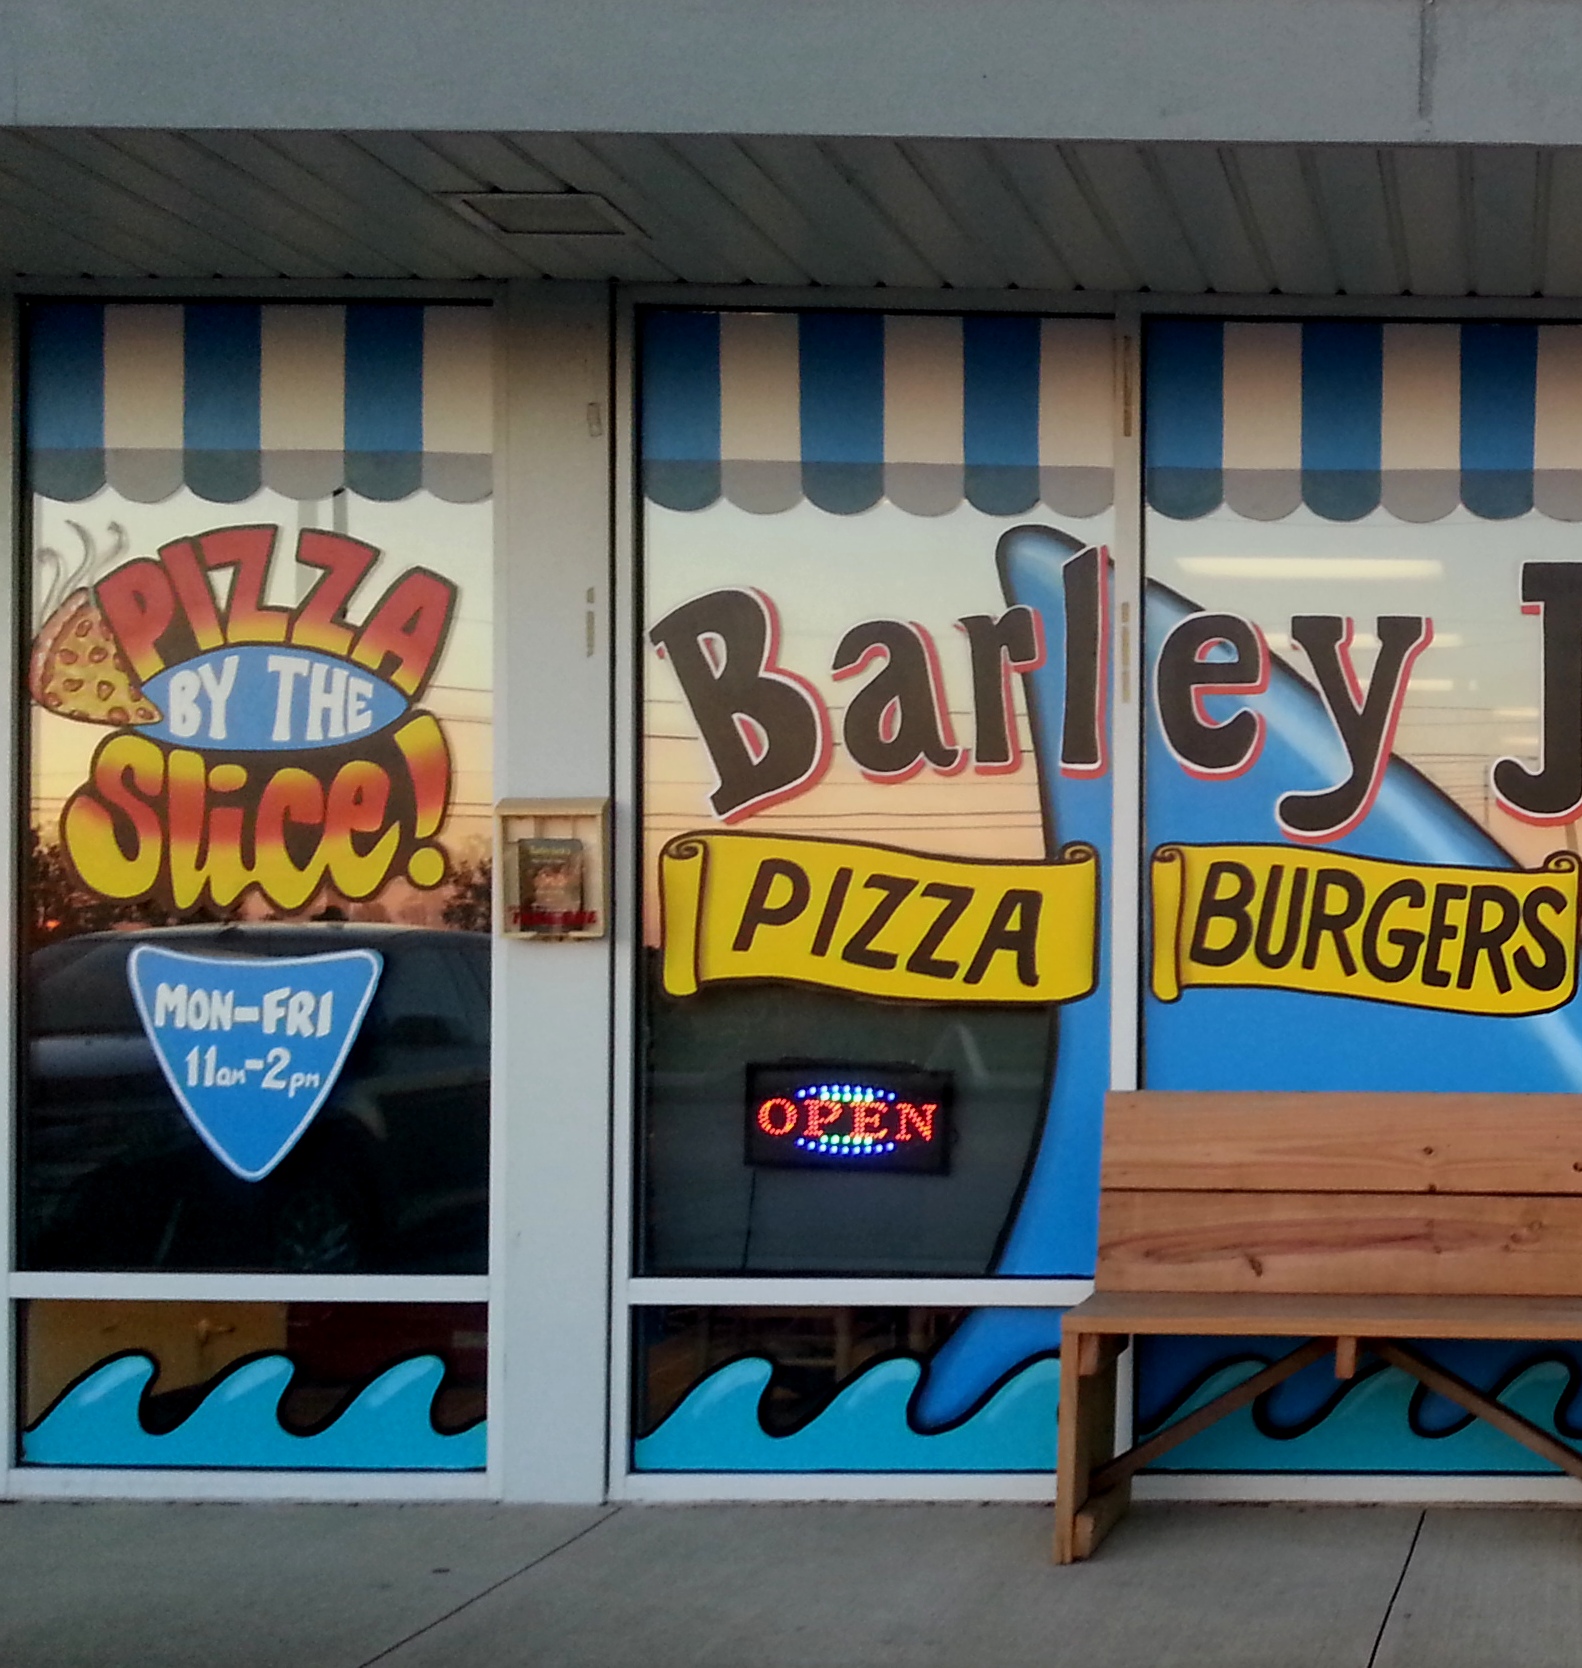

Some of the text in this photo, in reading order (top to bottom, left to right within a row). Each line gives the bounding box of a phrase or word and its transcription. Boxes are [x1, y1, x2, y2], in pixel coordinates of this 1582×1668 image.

[94, 523, 460, 702] PIZZA
[167, 655, 376, 742] BY THE
[648, 542, 1436, 844] Barley
[60, 708, 452, 910] Slice!
[732, 857, 1044, 988] PIZZA
[1189, 861, 1568, 996] BURGERS
[154, 982, 334, 1038] MON-FRI
[757, 1098, 937, 1141] OPEN
